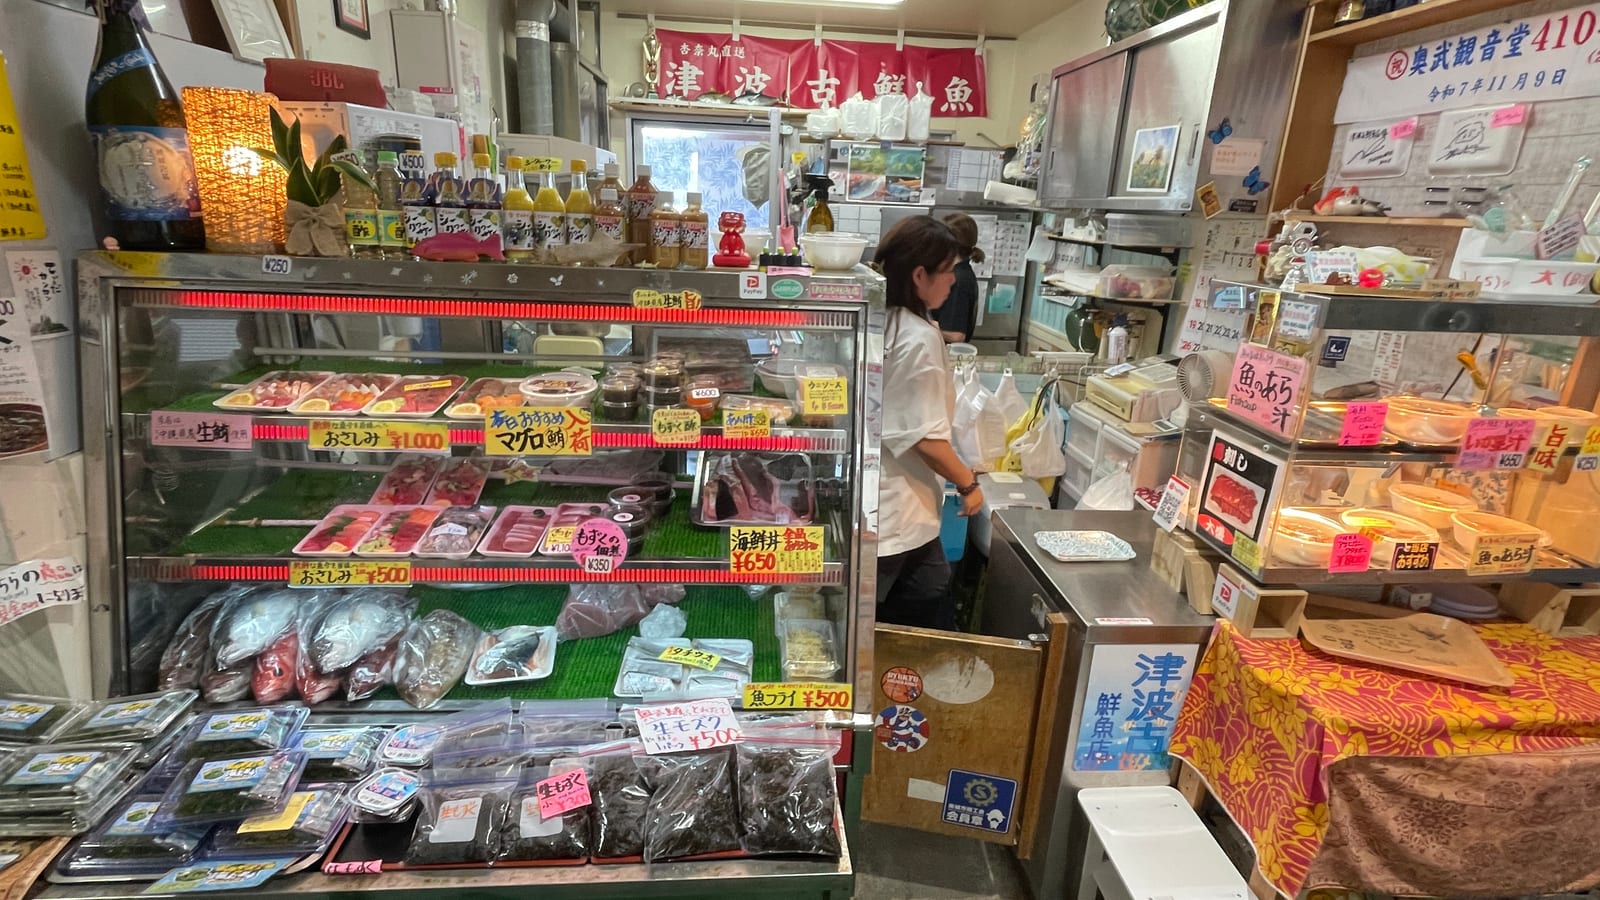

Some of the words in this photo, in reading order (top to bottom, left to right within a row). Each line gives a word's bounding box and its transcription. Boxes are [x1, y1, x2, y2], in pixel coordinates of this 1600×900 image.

[680, 42, 745, 59] 杏奈丸直送
[311, 69, 344, 89] JBL
[1428, 68, 1567, 103] 令和7年11月9日
[402, 155, 425, 169] ¥500
[264, 260, 288, 273] ¥250
[695, 389, 717, 397] ¥600
[490, 410, 565, 430] 本日おすすめ
[323, 430, 380, 447] おさしみ
[1533, 424, 1568, 469] 旨味
[1499, 453, 1523, 467] ¥650
[577, 528, 619, 545] もずくの
[731, 529, 782, 552] 海鮮丼
[588, 558, 610, 572] ¥350
[732, 552, 776, 572] ¥650
[1396, 554, 1430, 569] おすすめ
[300, 570, 352, 585] おさしみ
[368, 566, 409, 584] ¥500
[749, 690, 796, 707] 魚フライ
[802, 690, 849, 708] ¥500
[1126, 652, 1187, 753] 津波古
[652, 717, 721, 735] 生モズク
[1087, 692, 1122, 761] 鮮魚店
[539, 773, 585, 800] 生もずく
